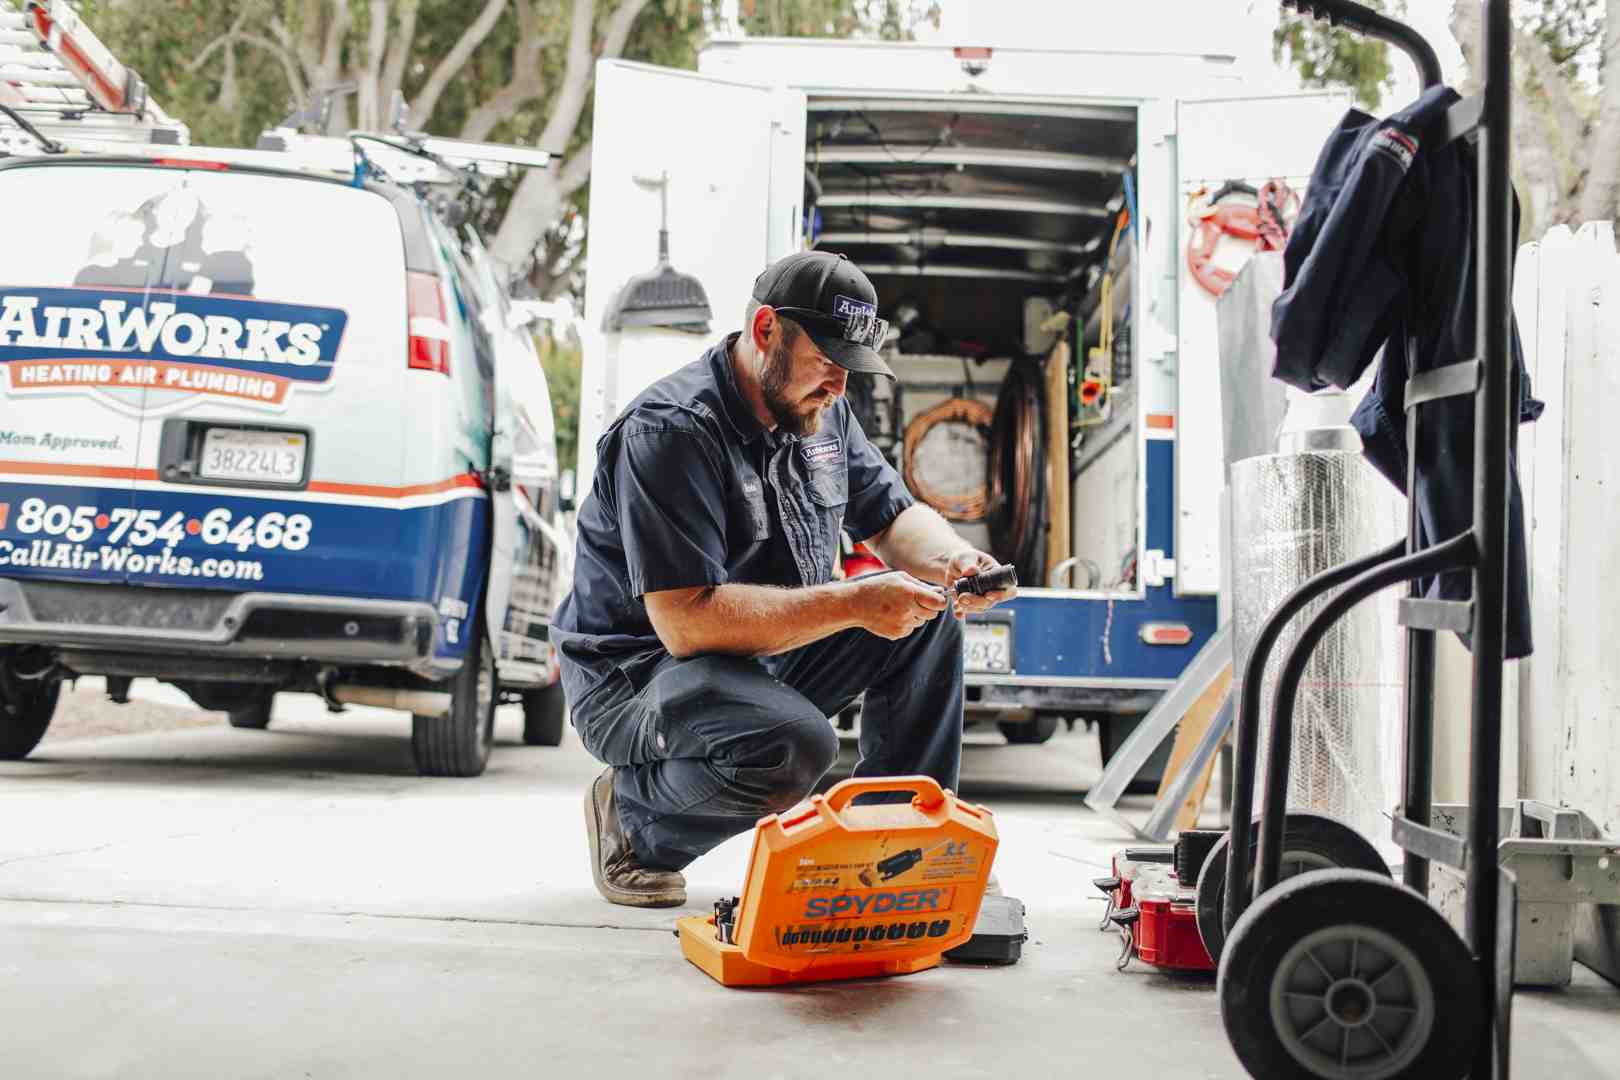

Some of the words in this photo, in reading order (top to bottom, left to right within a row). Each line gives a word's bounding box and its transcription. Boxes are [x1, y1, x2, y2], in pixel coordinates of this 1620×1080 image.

[21, 364, 112, 384] HEATING
[120, 365, 158, 385] AIR
[165, 367, 277, 399] PLUMBING
[0, 431, 36, 446] Mom
[209, 448, 297, 475] 38224L3
[0, 540, 264, 581] CallAirWorks.com
[805, 888, 941, 918] SPYDER
